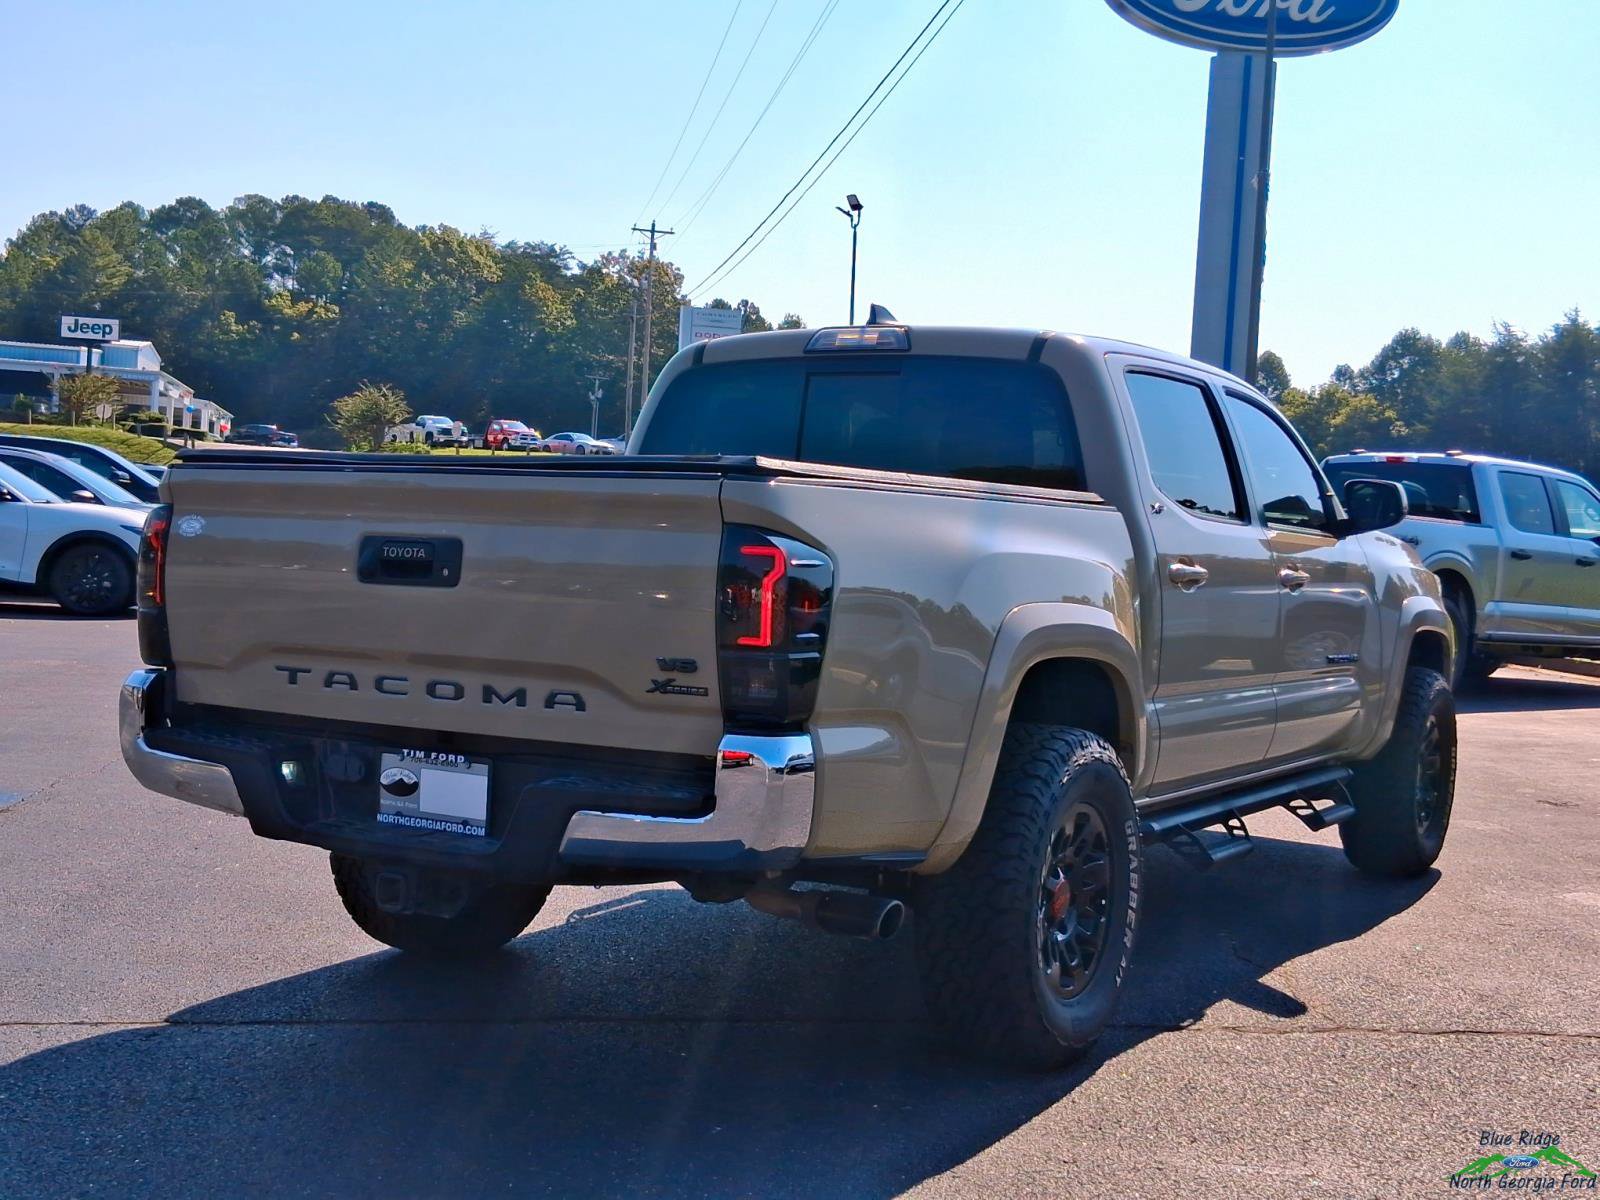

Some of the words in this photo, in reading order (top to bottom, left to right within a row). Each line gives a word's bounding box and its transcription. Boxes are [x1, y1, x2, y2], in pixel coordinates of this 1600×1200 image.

[67, 319, 113, 338] Jeep
[383, 546, 425, 558] TOYOTA
[274, 665, 587, 712] TACOMA
[402, 748, 425, 758] TIM
[431, 752, 465, 763] FORD
[377, 813, 486, 836] NORTHGEORGIAFORD.COM
[1124, 819, 1138, 948] GRABBER
